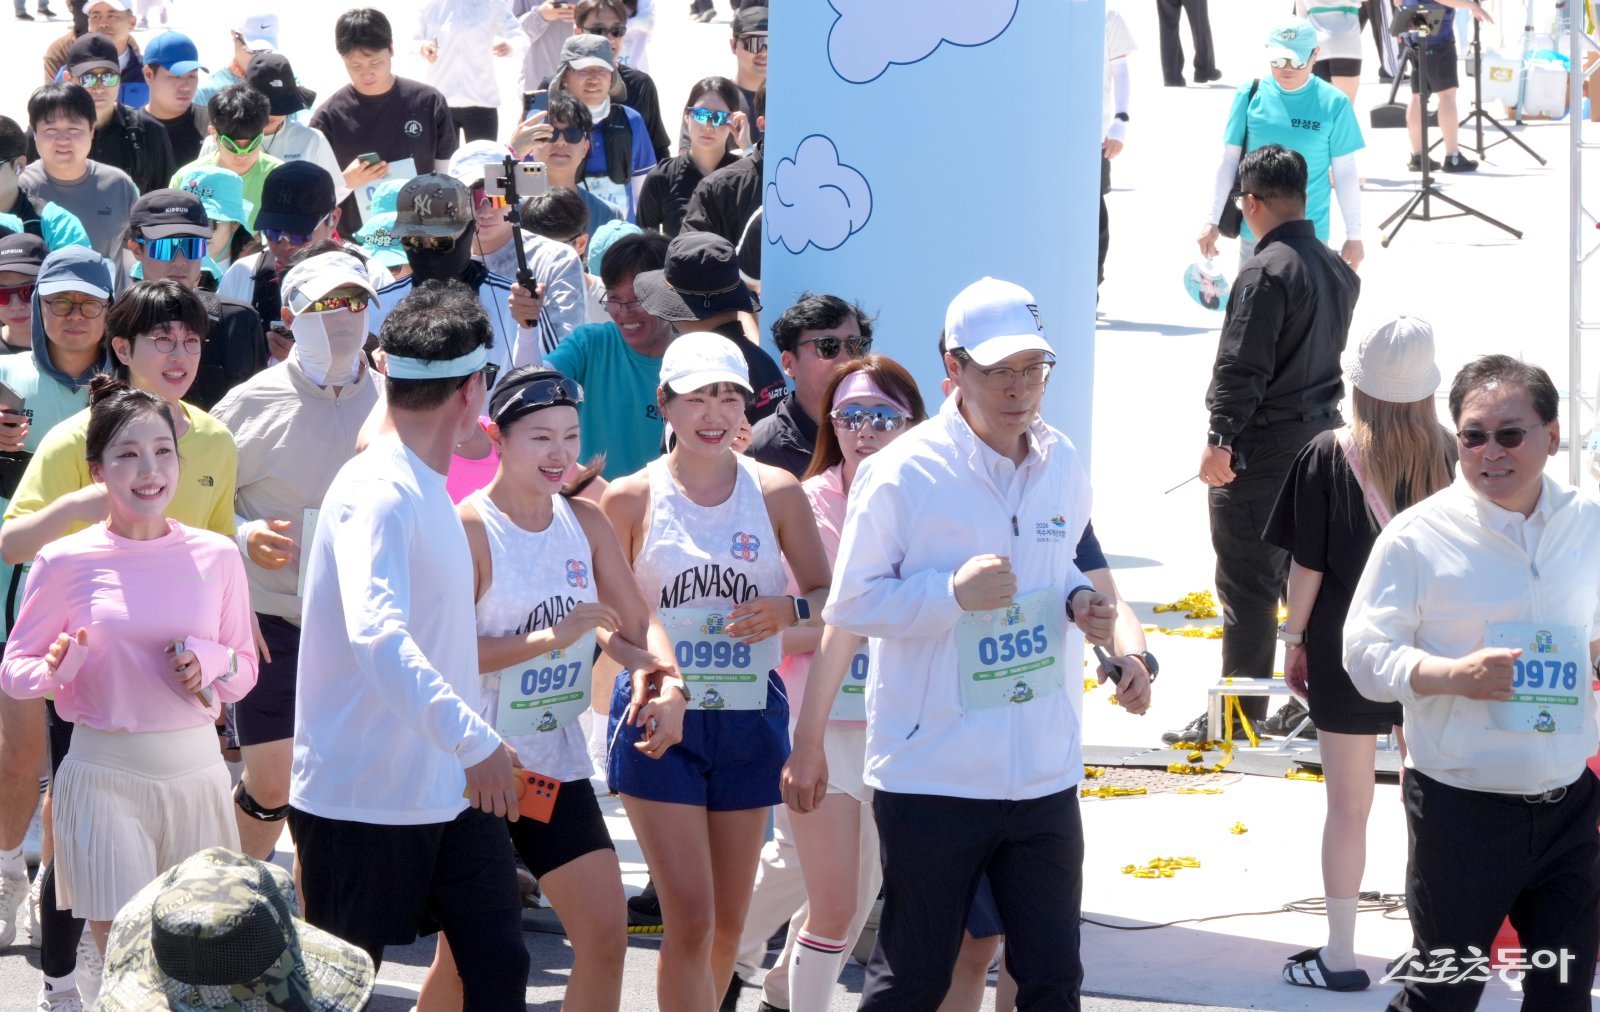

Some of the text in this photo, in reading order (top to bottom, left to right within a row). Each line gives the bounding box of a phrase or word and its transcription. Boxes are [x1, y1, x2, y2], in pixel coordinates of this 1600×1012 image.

[1291, 118, 1321, 131] 안성훈
[413, 193, 433, 216] NY
[515, 595, 584, 635] MENAS
[675, 640, 751, 668] 0998
[978, 624, 1048, 666] 0365
[521, 661, 582, 696] 0997
[1512, 659, 1578, 690] 0978
